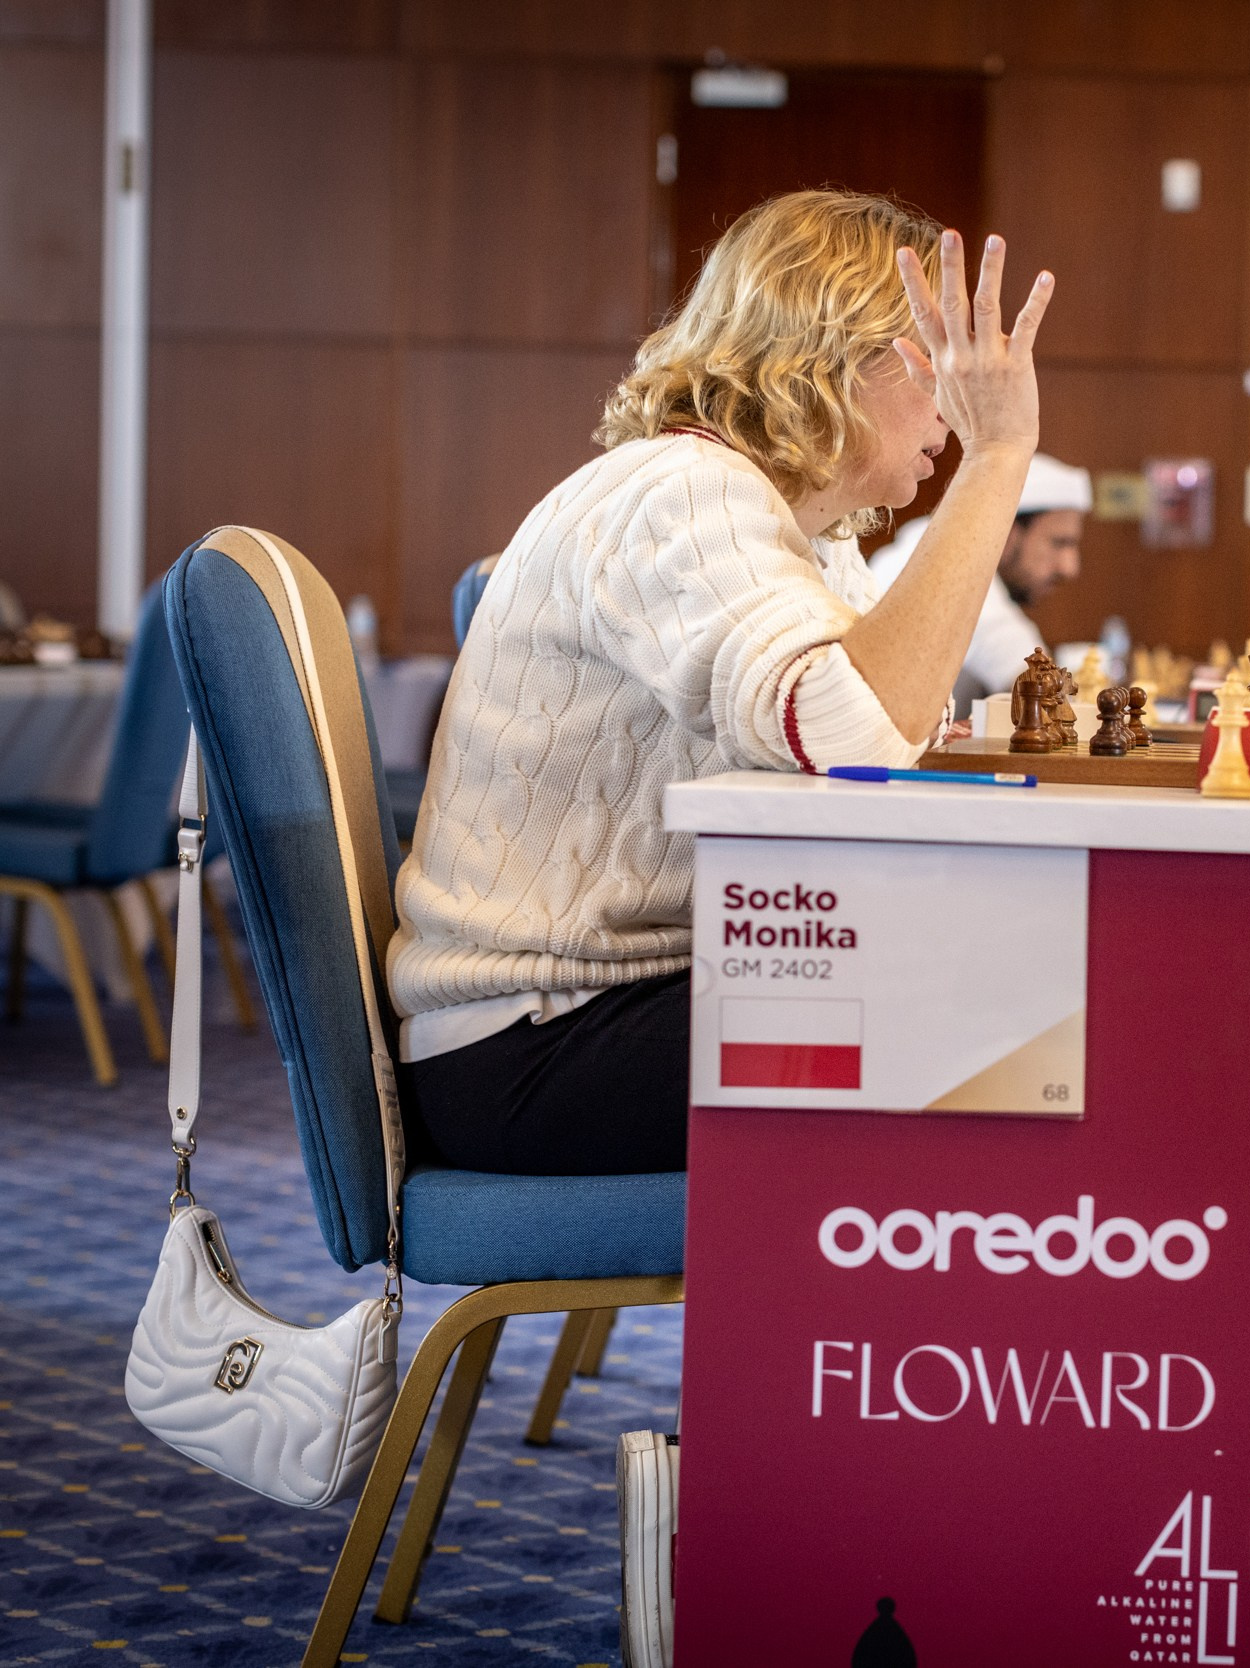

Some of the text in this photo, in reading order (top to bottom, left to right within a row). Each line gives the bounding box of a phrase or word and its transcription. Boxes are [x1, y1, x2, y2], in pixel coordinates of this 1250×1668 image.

[724, 883, 837, 912] Socko
[724, 920, 857, 949] Monika
[721, 957, 833, 980] GM 2402
[1041, 1083, 1070, 1102] 68
[818, 1194, 1228, 1281] ooredoo
[811, 1340, 1216, 1432] FLOWARD
[1144, 1579, 1194, 1592] PURE
[1096, 1595, 1194, 1610] ALKALINE
[1129, 1614, 1193, 1627] WATER
[1140, 1633, 1192, 1646] FROM
[1129, 1650, 1191, 1663] QATAR
